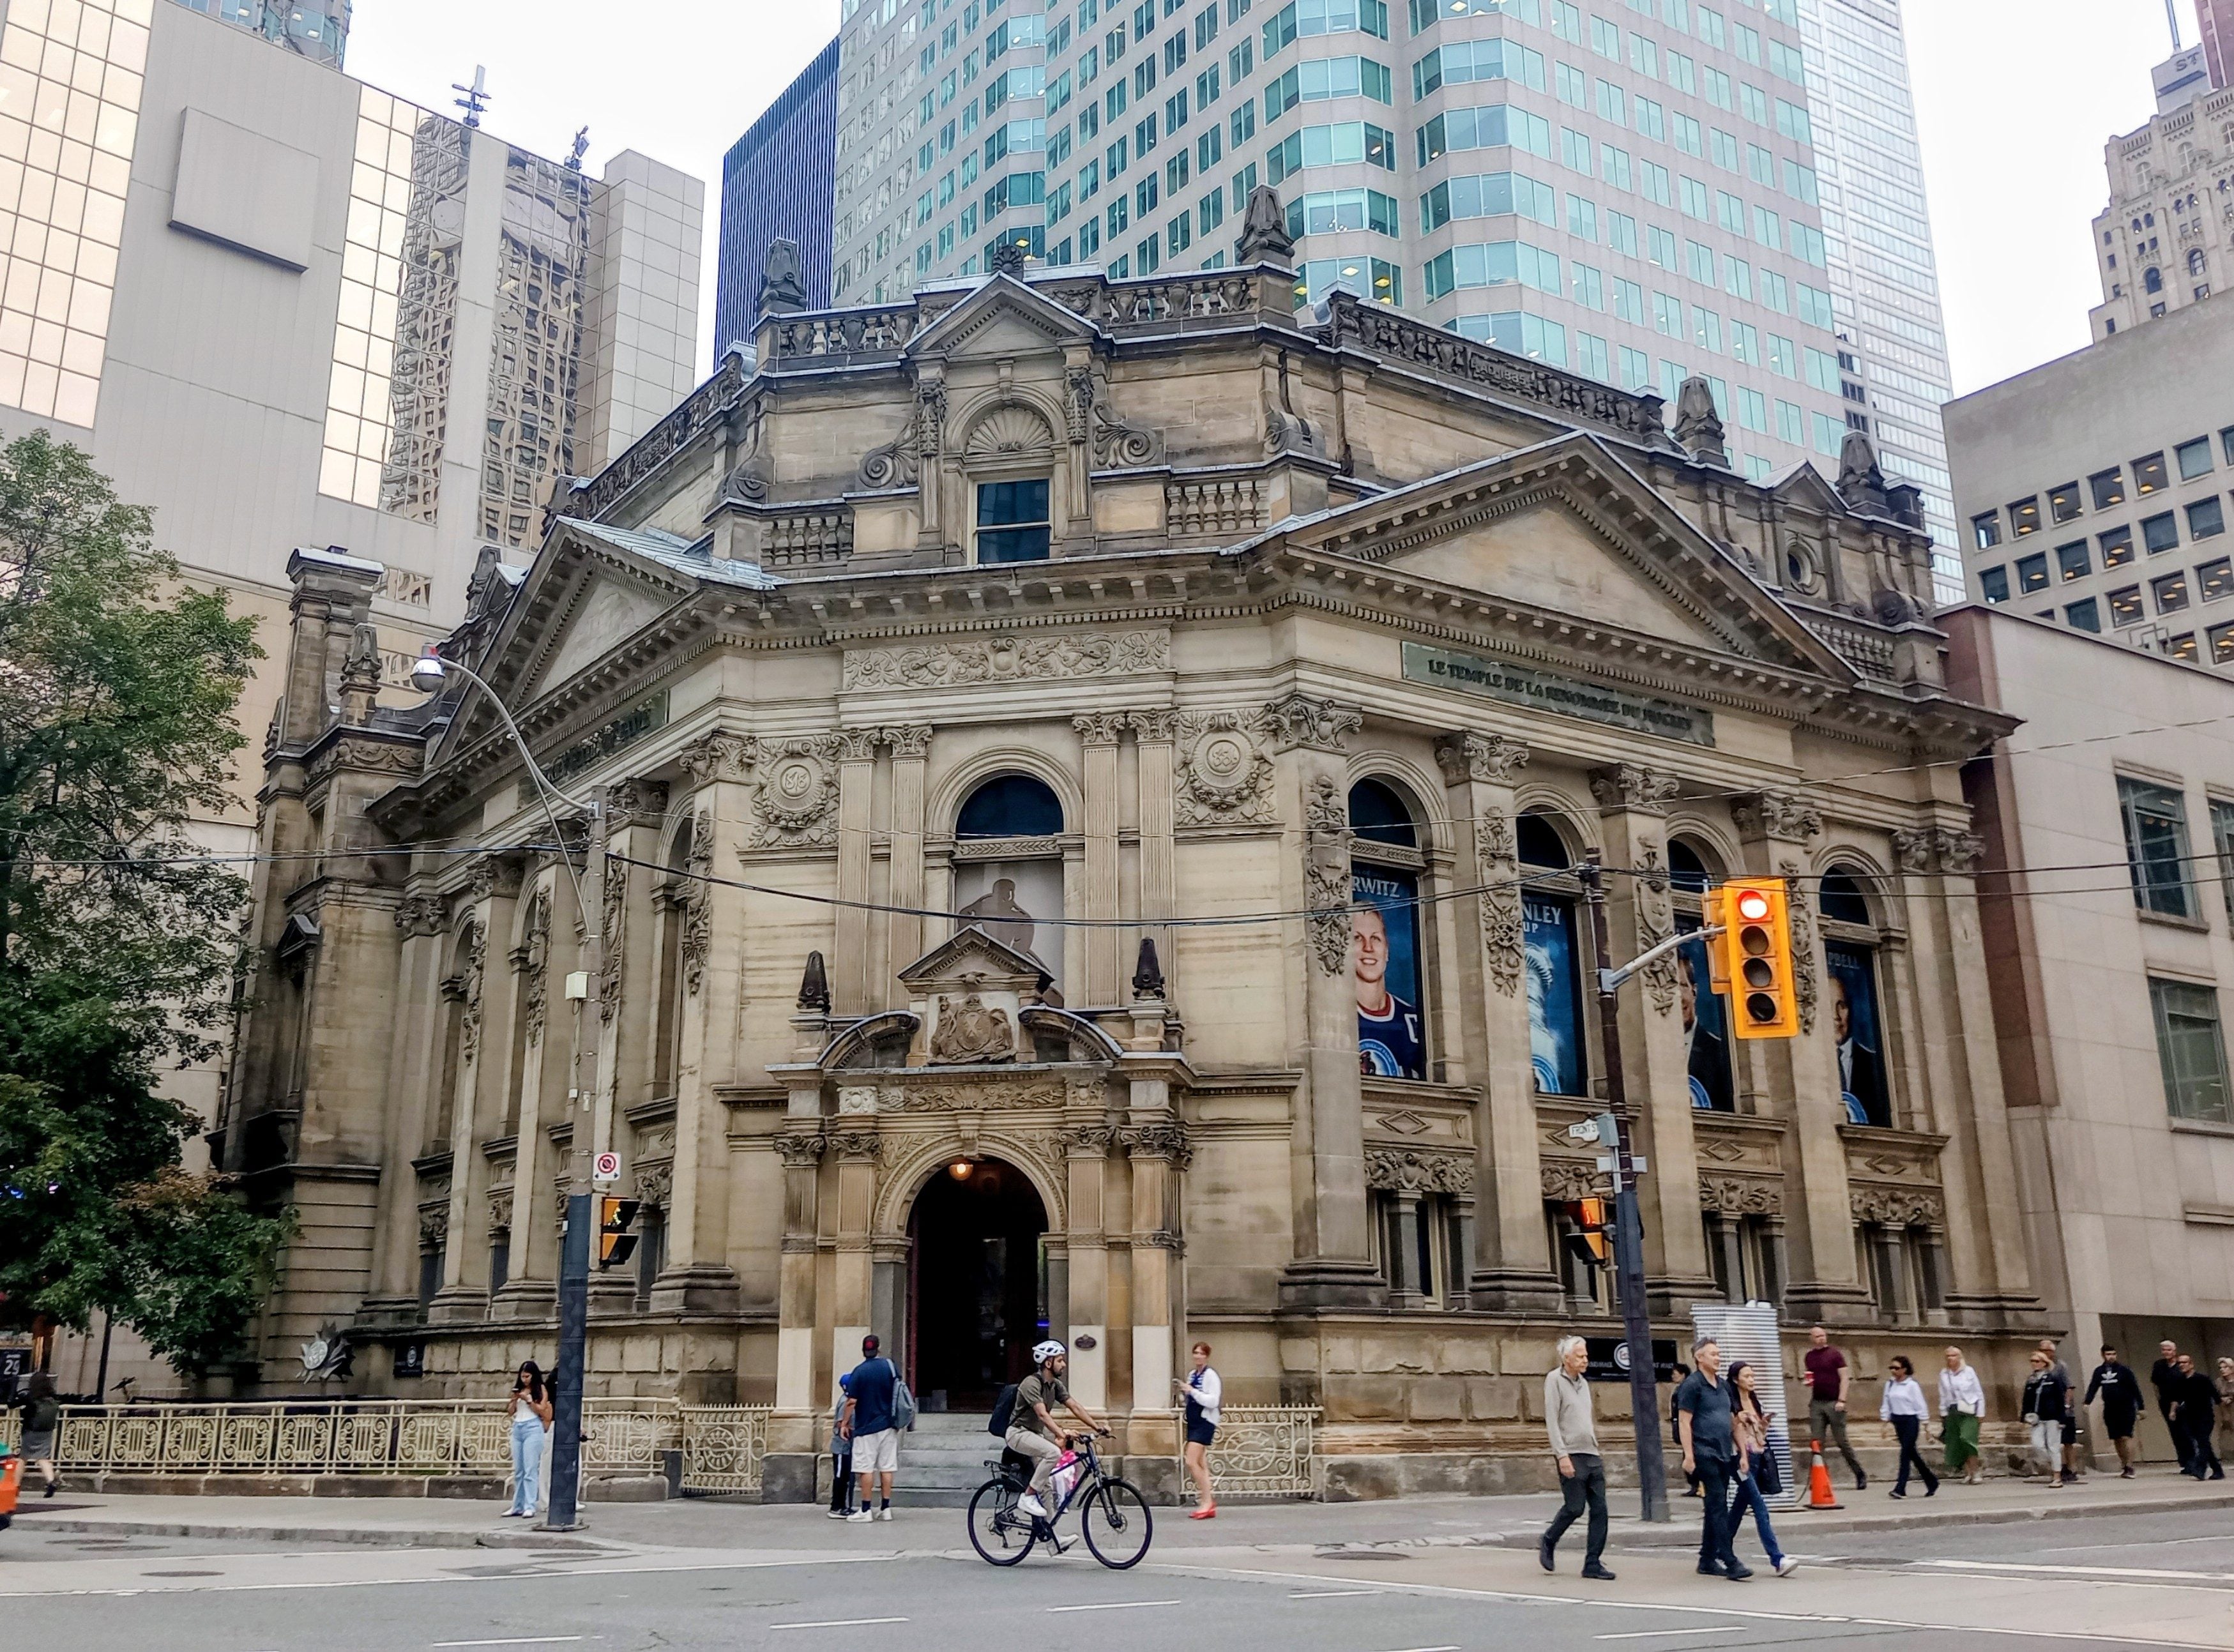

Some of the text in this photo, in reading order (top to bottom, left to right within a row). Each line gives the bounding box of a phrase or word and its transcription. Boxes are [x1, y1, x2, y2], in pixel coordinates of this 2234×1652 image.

[1427, 659, 1447, 675] LE
[1448, 663, 1503, 688] TEMPLE
[1505, 678, 1524, 692] DE
[1526, 681, 1544, 697] LA
